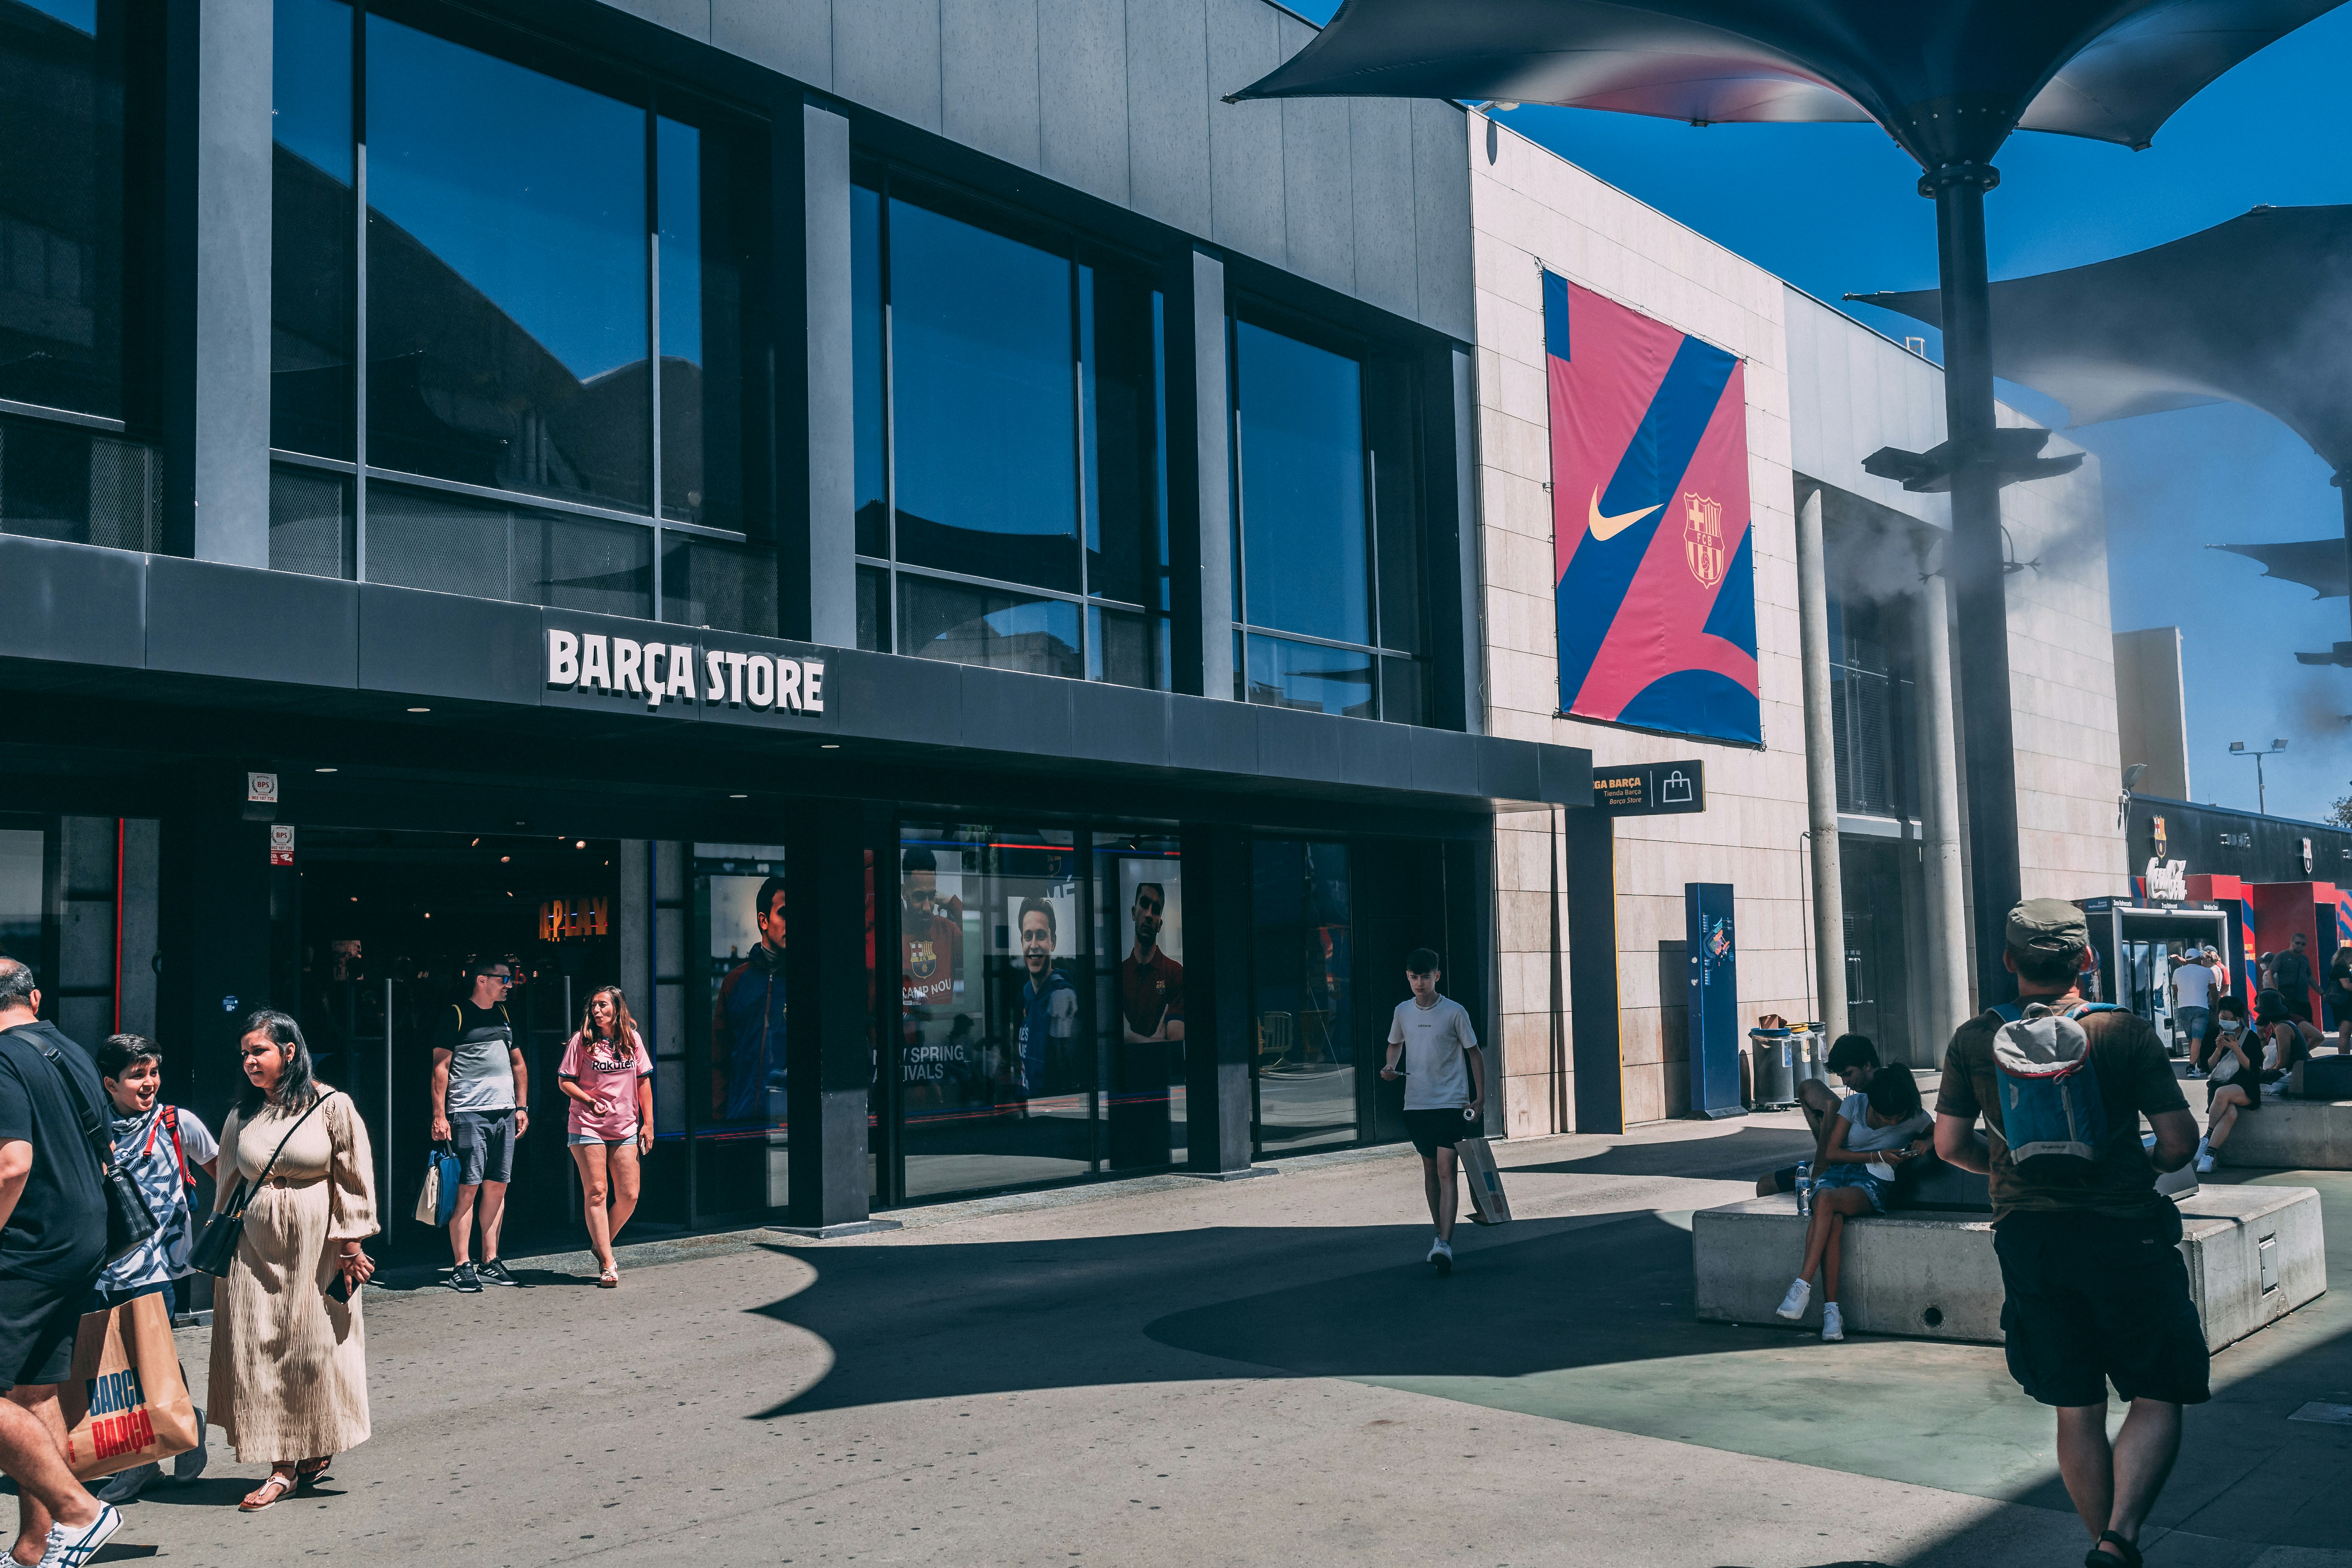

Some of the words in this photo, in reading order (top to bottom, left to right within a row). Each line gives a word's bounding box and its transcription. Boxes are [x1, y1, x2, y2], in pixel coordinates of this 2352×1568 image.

[1697, 532, 1712, 546] FCB
[547, 629, 696, 706] BARÇA
[706, 651, 824, 712] STORE
[1593, 780, 1607, 789] GA
[1609, 778, 1641, 788] BARÇA
[931, 978, 951, 995] NOU
[592, 1060, 635, 1070] Rakuten
[85, 1366, 147, 1417] BARÇA
[91, 1409, 156, 1460] BARÇA
